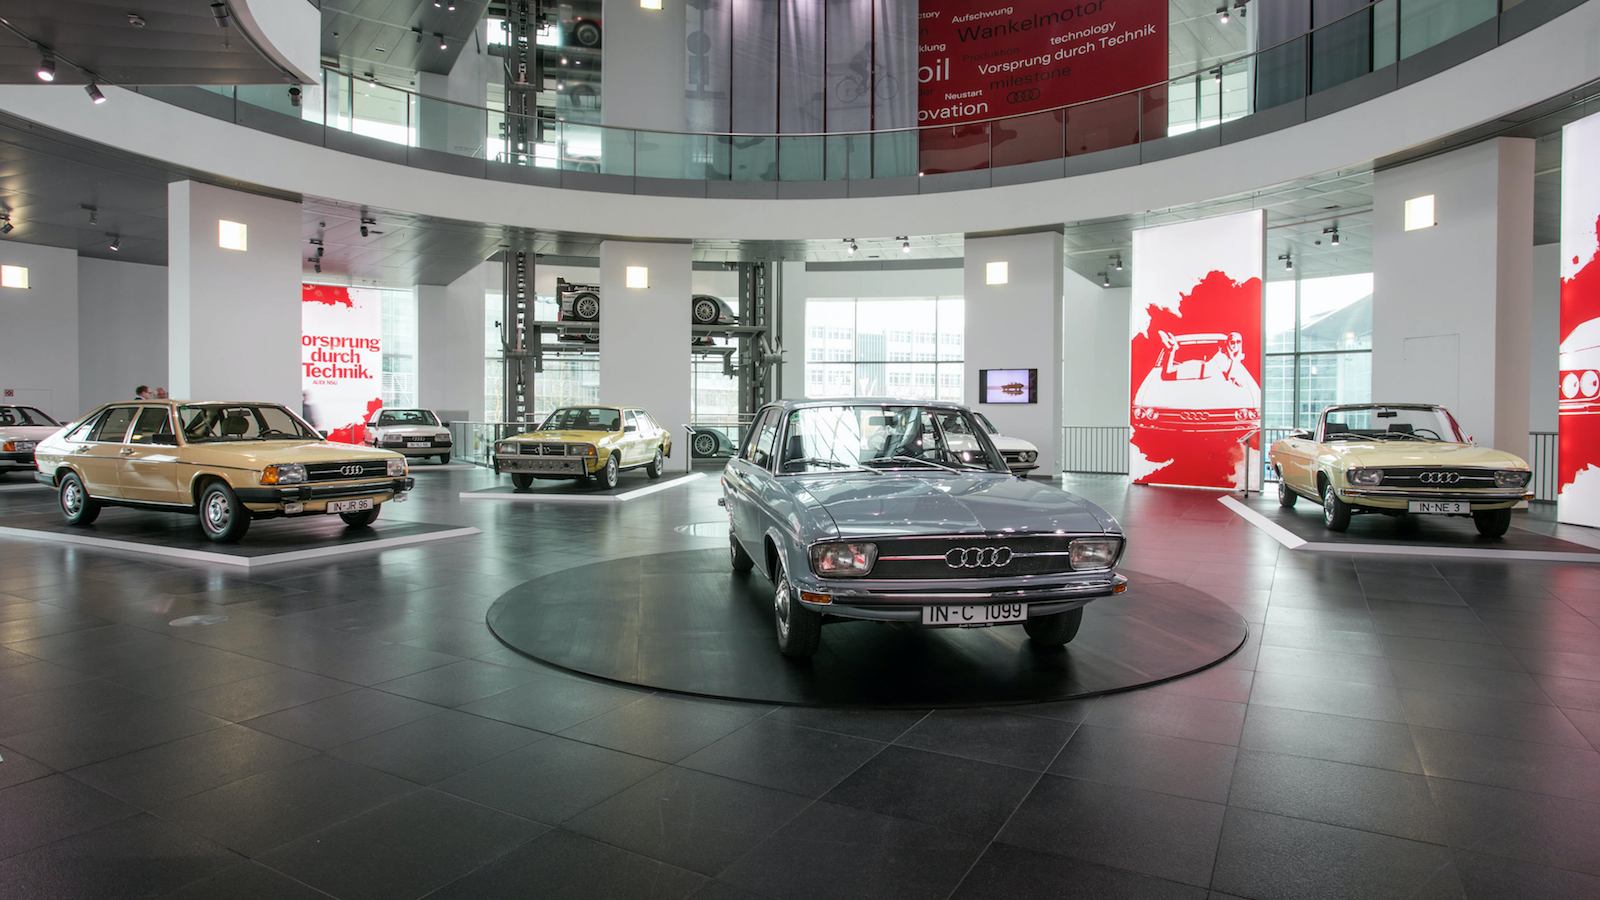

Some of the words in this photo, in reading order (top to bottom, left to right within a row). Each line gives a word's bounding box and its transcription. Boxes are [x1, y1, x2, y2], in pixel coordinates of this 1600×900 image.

[952, 6, 1014, 24] Aufschwung
[957, 0, 1106, 42] Wankelmotor
[1050, 21, 1117, 46] technology
[963, 47, 1020, 63] Produktion
[978, 53, 1051, 75] Vorsprung
[1054, 42, 1096, 60] durch
[1098, 24, 1156, 49] Technik
[990, 66, 1071, 90] milestone
[944, 89, 983, 101] Neustart
[302, 334, 381, 352] orsprung
[310, 347, 360, 363] durch
[302, 362, 373, 379] Technik.
[358, 500, 368, 509] 96
[1419, 502, 1450, 512] IN-NE
[1454, 503, 1460, 512] 3
[984, 604, 1022, 620] 1099
